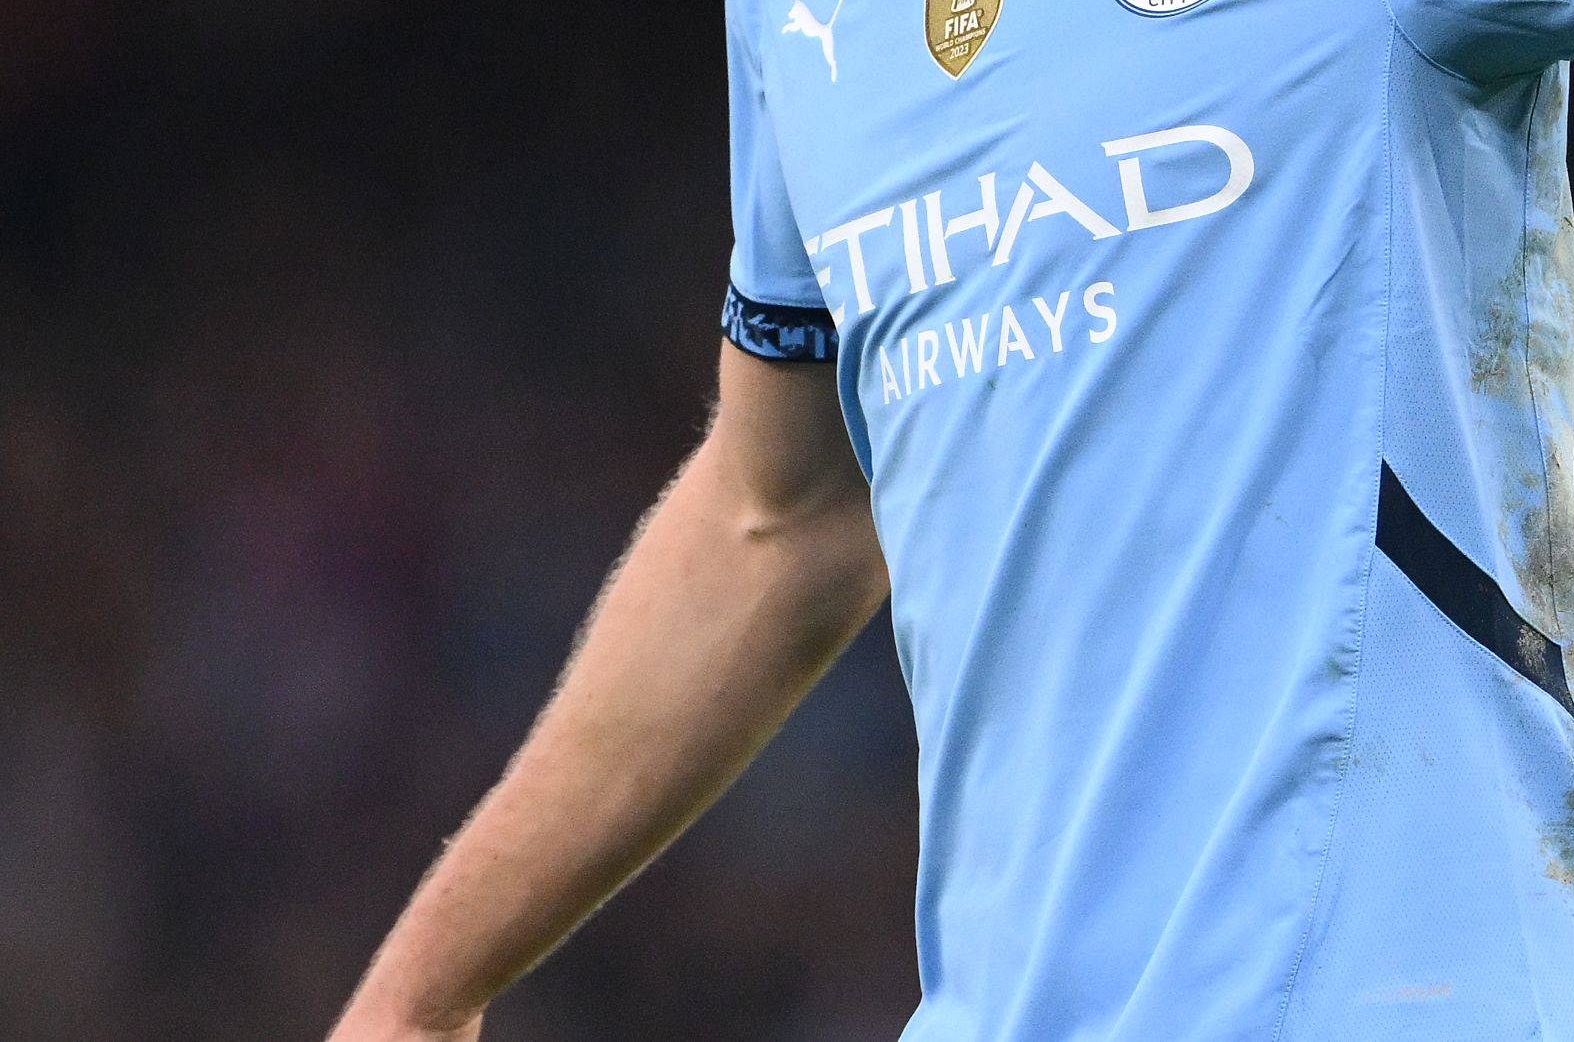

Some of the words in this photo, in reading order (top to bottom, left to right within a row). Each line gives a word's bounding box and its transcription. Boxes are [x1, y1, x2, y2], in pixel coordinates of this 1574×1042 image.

[944, 10, 979, 40] FIFA
[949, 43, 969, 59] 2023
[879, 281, 1118, 405] AIRWAYS
